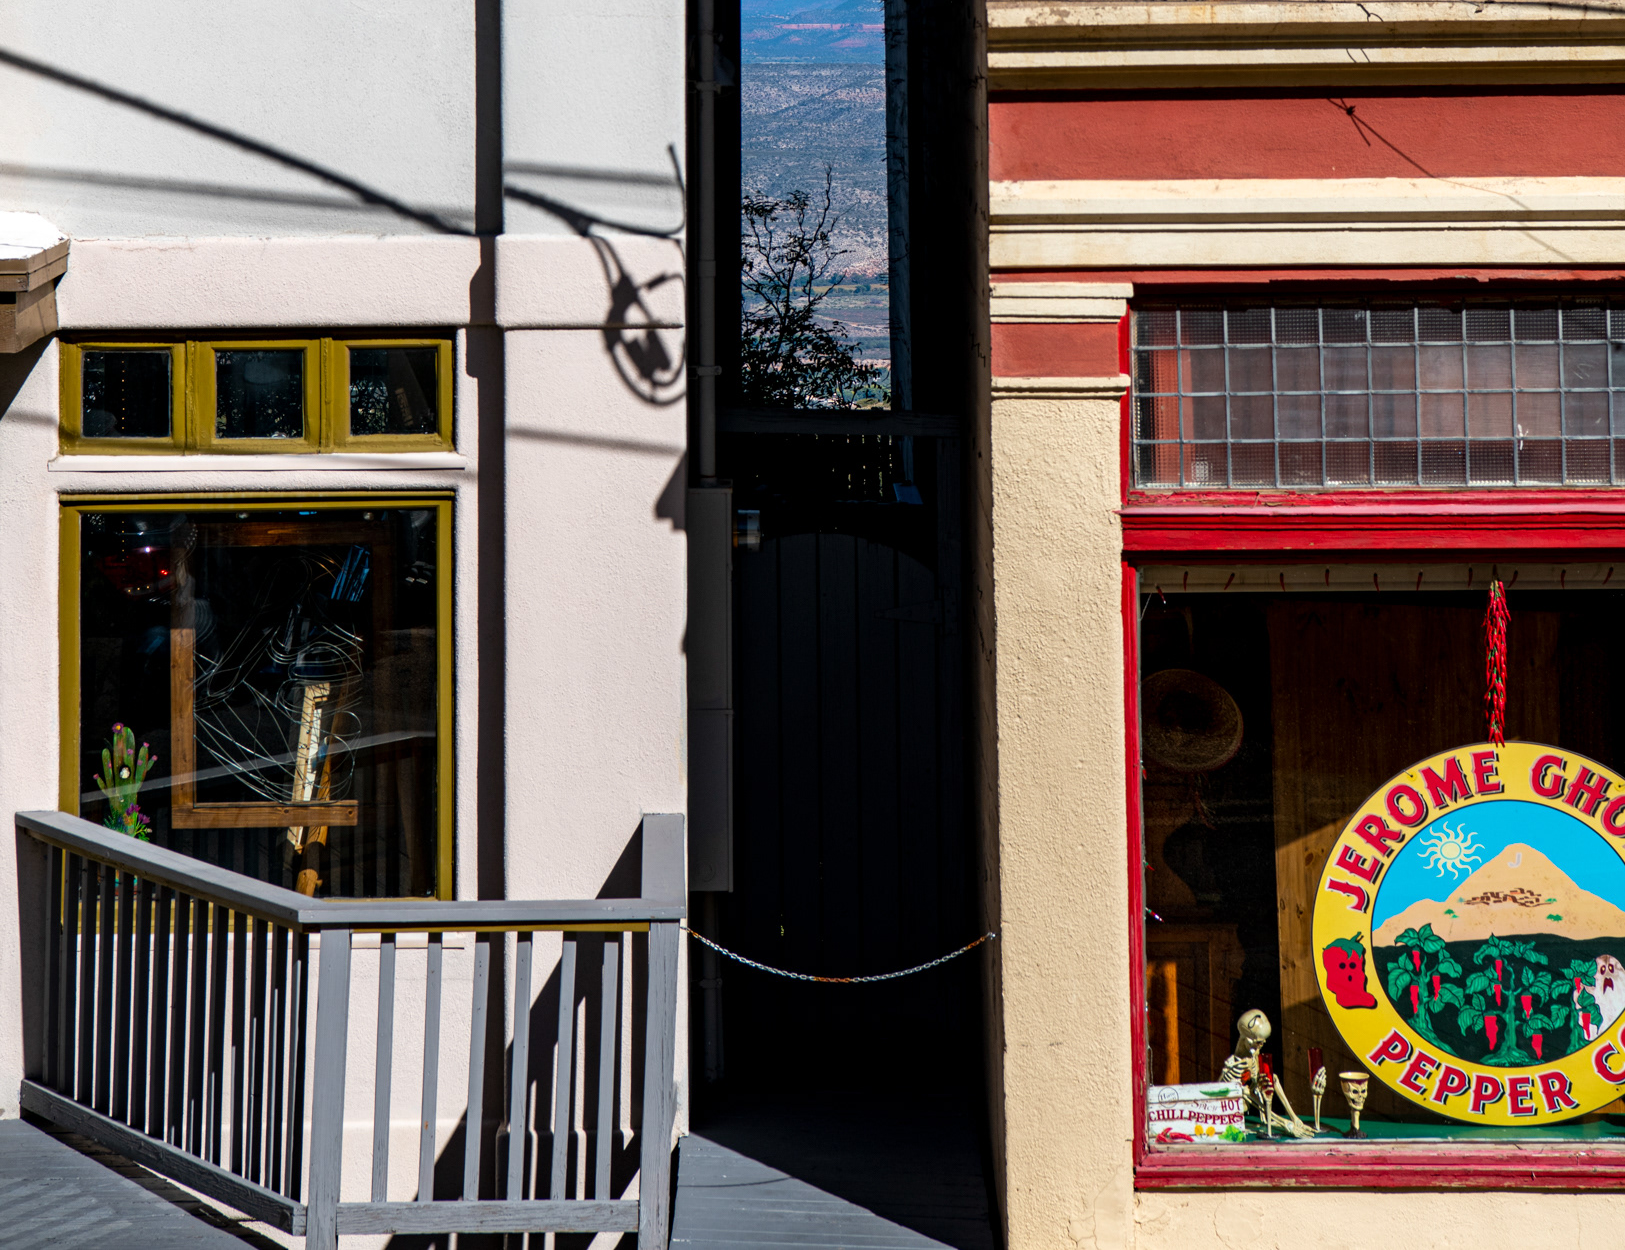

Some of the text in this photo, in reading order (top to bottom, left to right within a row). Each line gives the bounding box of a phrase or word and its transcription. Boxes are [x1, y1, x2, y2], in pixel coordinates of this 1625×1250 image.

[1326, 749, 1504, 914] JEROME
[1507, 852, 1522, 868] J
[1366, 1022, 1625, 1116] PEPPER C
[1220, 1098, 1241, 1112] HOT
[1187, 1110, 1244, 1125] PEPPERS
